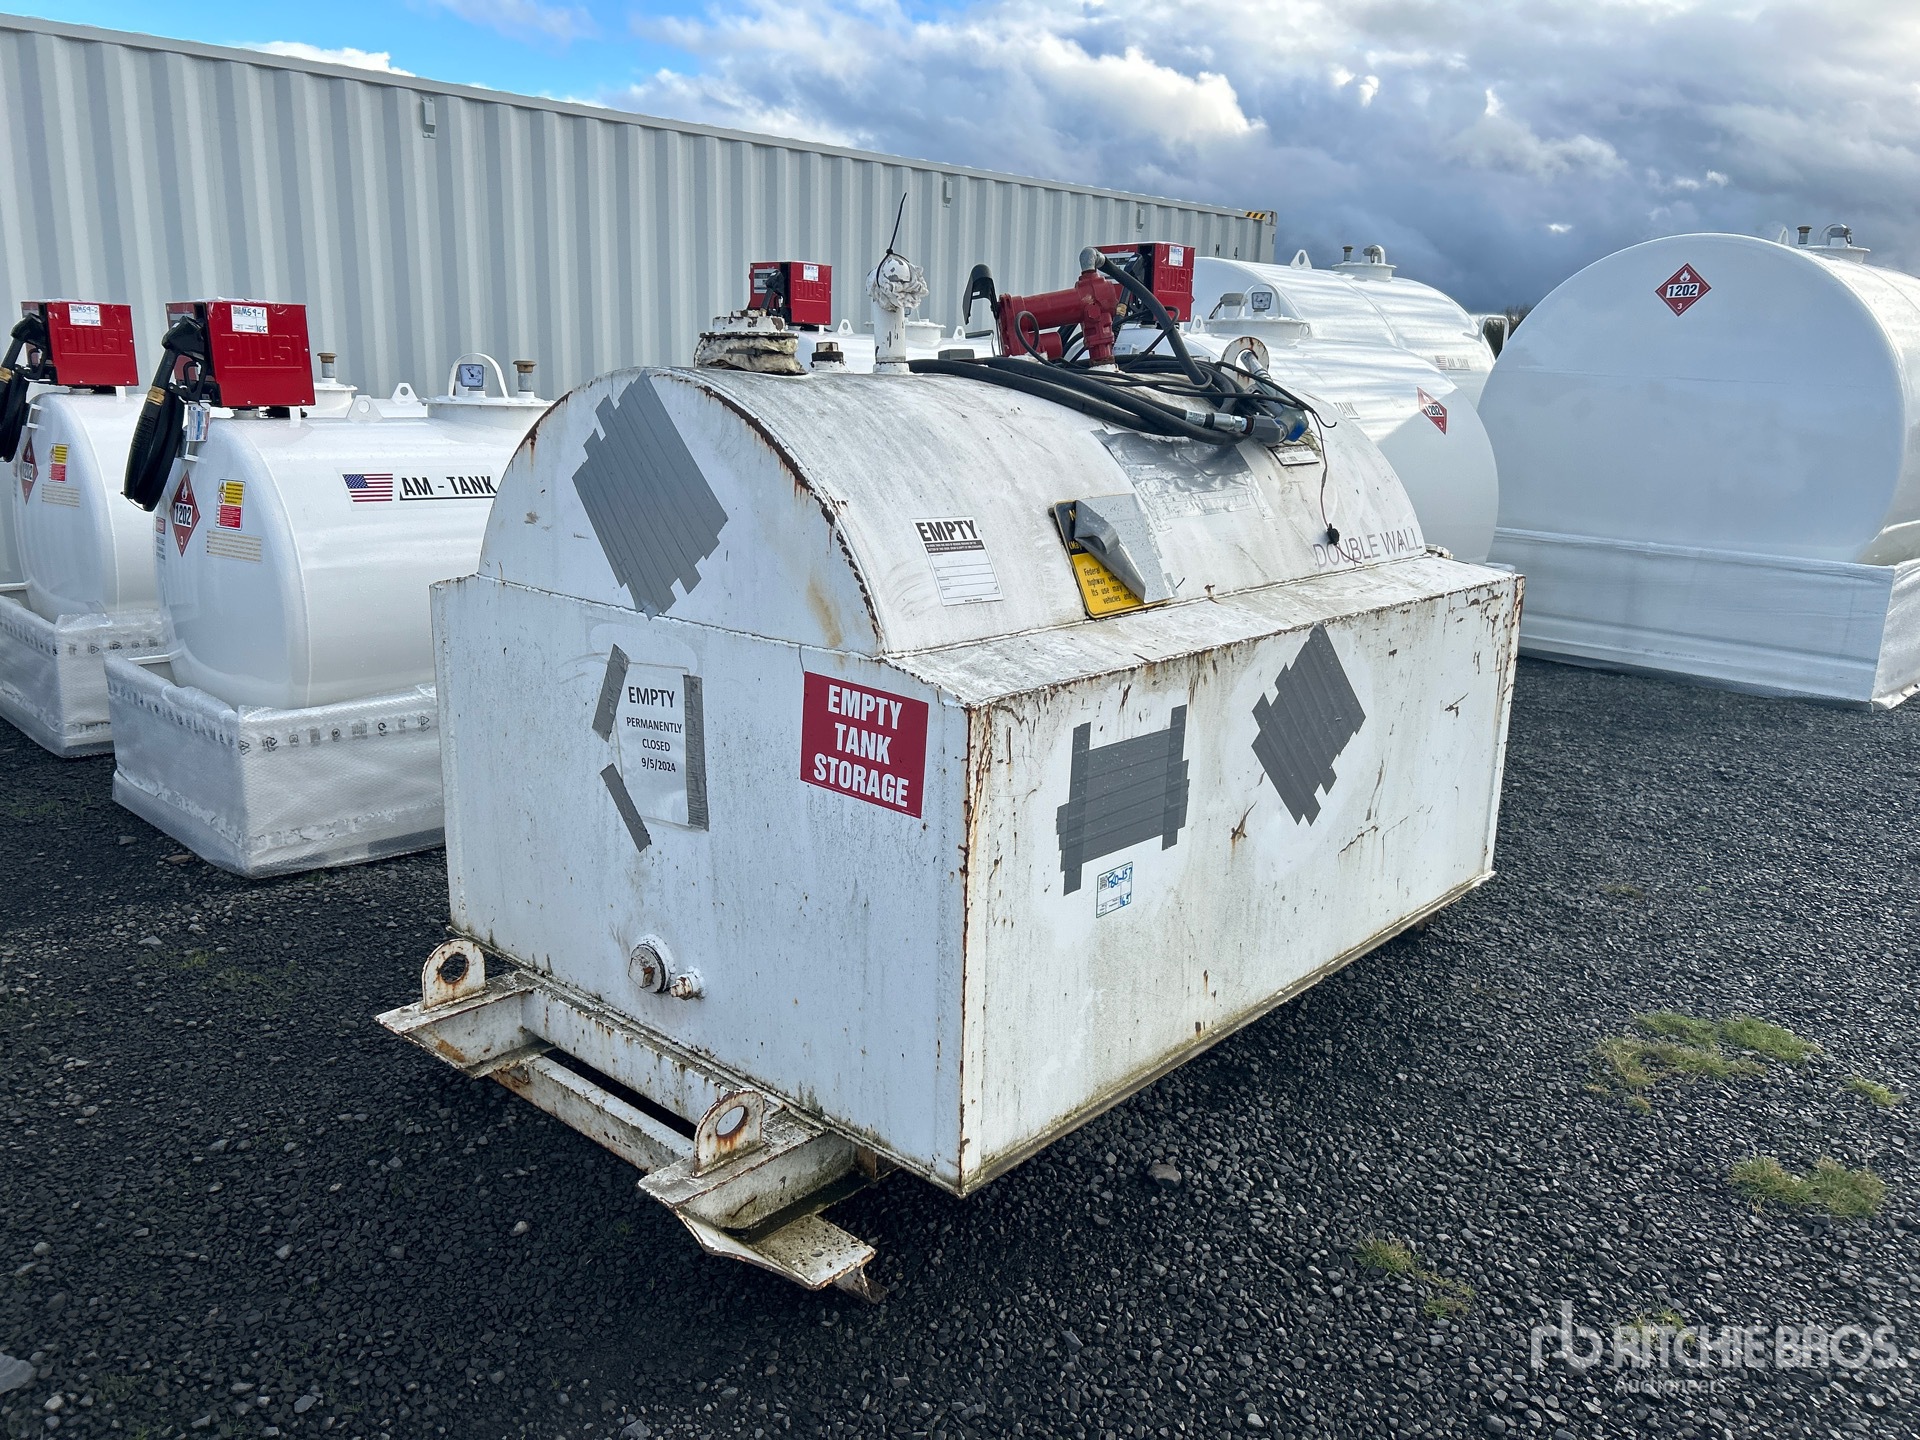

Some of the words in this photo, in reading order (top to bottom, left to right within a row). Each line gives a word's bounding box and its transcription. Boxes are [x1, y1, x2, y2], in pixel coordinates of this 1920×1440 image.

[1669, 284, 1698, 297] 1202
[1425, 403, 1444, 417] 1202
[402, 477, 434, 496] AM
[446, 475, 497, 495] TANK
[175, 503, 192, 526] 1202
[915, 520, 978, 542] EMPTY
[180, 535, 184, 546] 3
[1313, 534, 1380, 568] DOUBLE
[1380, 527, 1423, 555] WALL
[1083, 567, 1101, 576] Federal
[1086, 577, 1106, 587] highway
[1091, 588, 1099, 597] Its
[1101, 586, 1110, 594] use
[1112, 584, 1123, 593] may
[1103, 594, 1121, 605] vehicles
[628, 686, 675, 708] EMPTY
[827, 685, 903, 730] EMPTY
[626, 716, 682, 734] PERMANENTLY
[642, 738, 671, 753] CLOSED
[834, 723, 892, 766] TANK
[641, 756, 676, 773] 9/5/2024
[813, 753, 909, 807] STORAGE
